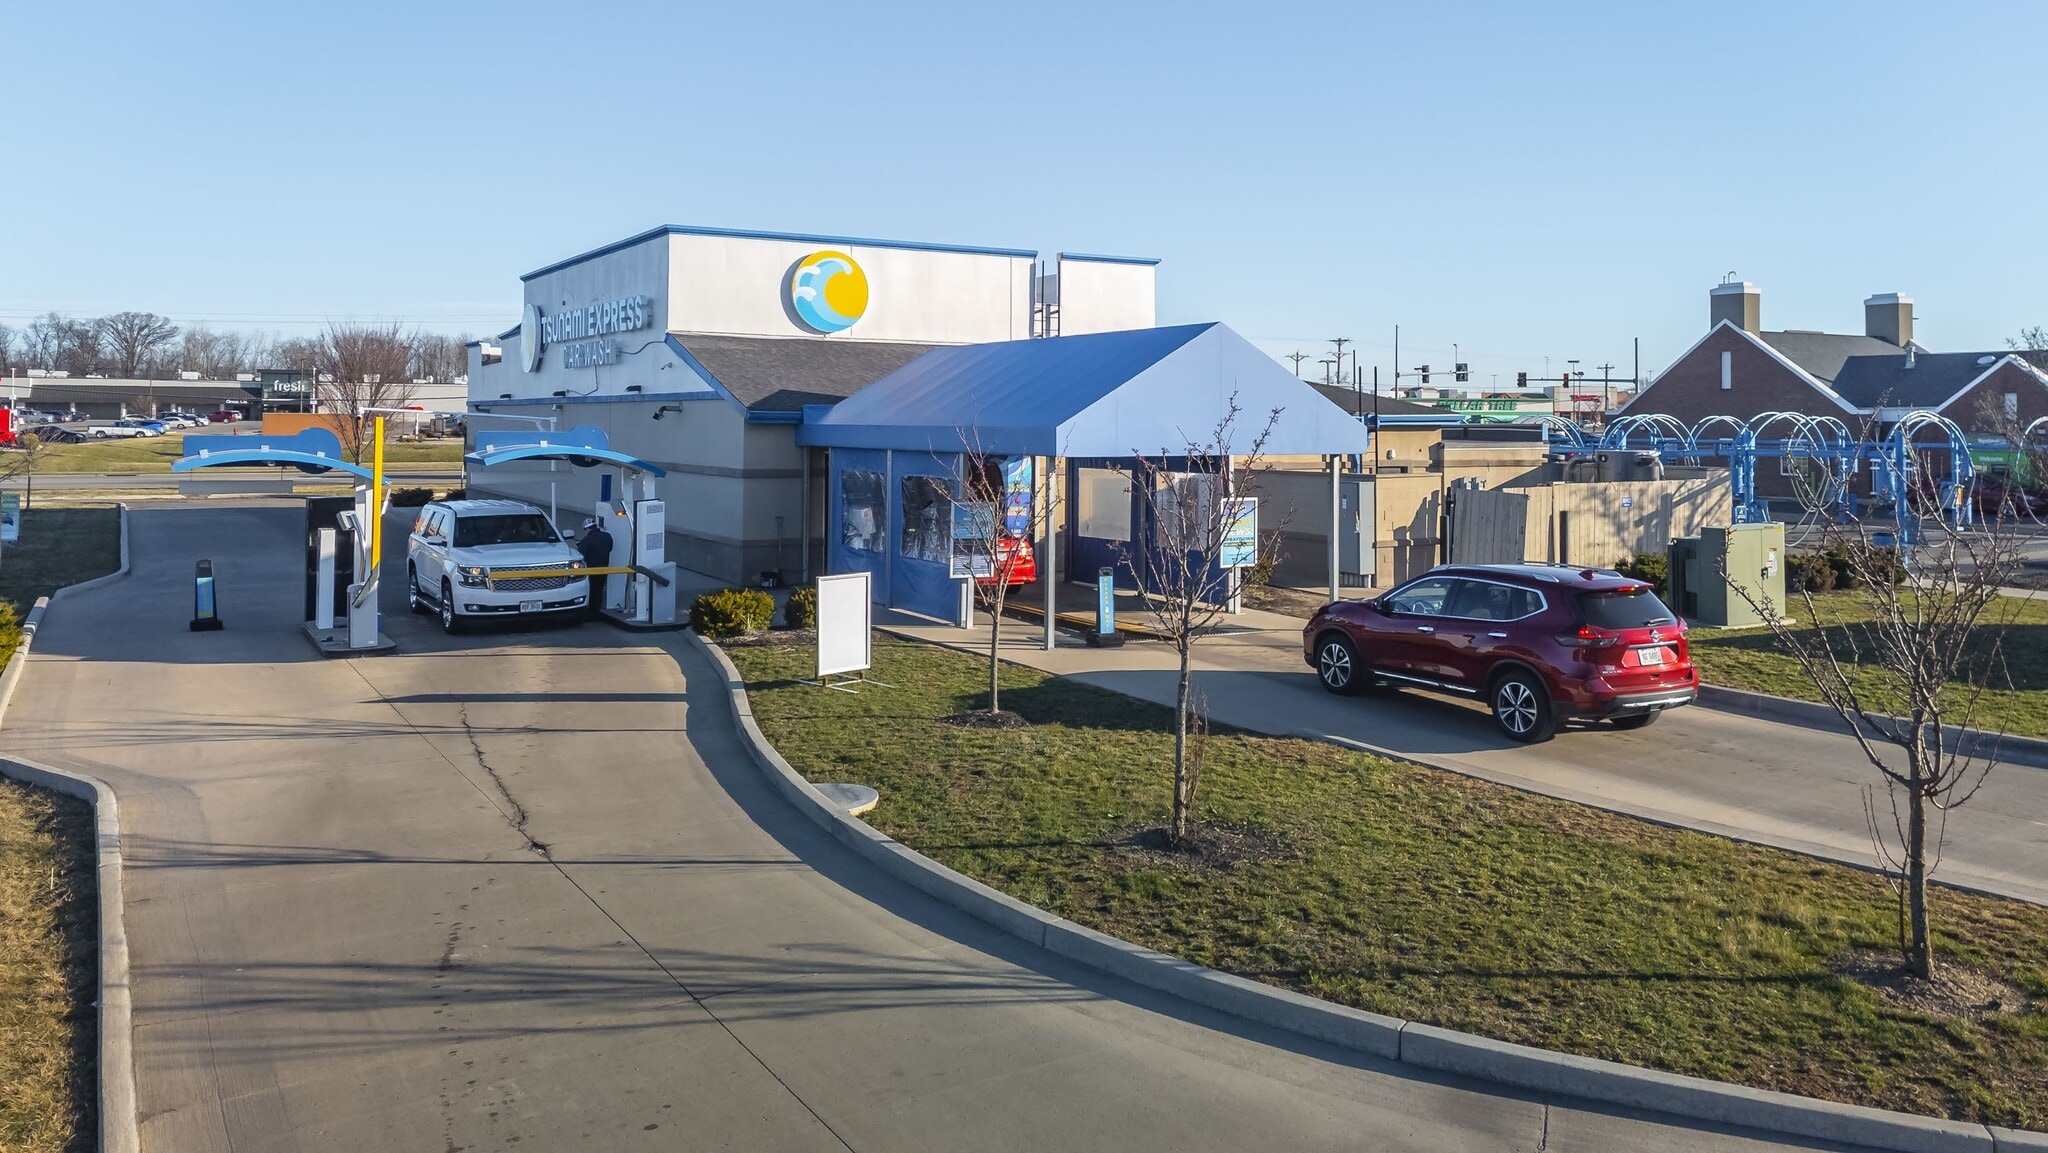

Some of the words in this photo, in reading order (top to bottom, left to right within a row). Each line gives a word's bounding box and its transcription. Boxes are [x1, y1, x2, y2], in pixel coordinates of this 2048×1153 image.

[541, 308, 585, 344] TSUNAMI
[588, 295, 643, 336] EXPRESS
[564, 344, 581, 368] CAR
[584, 340, 613, 366] WASH
[274, 380, 305, 392] fresh
[1488, 401, 1518, 411] TREE
